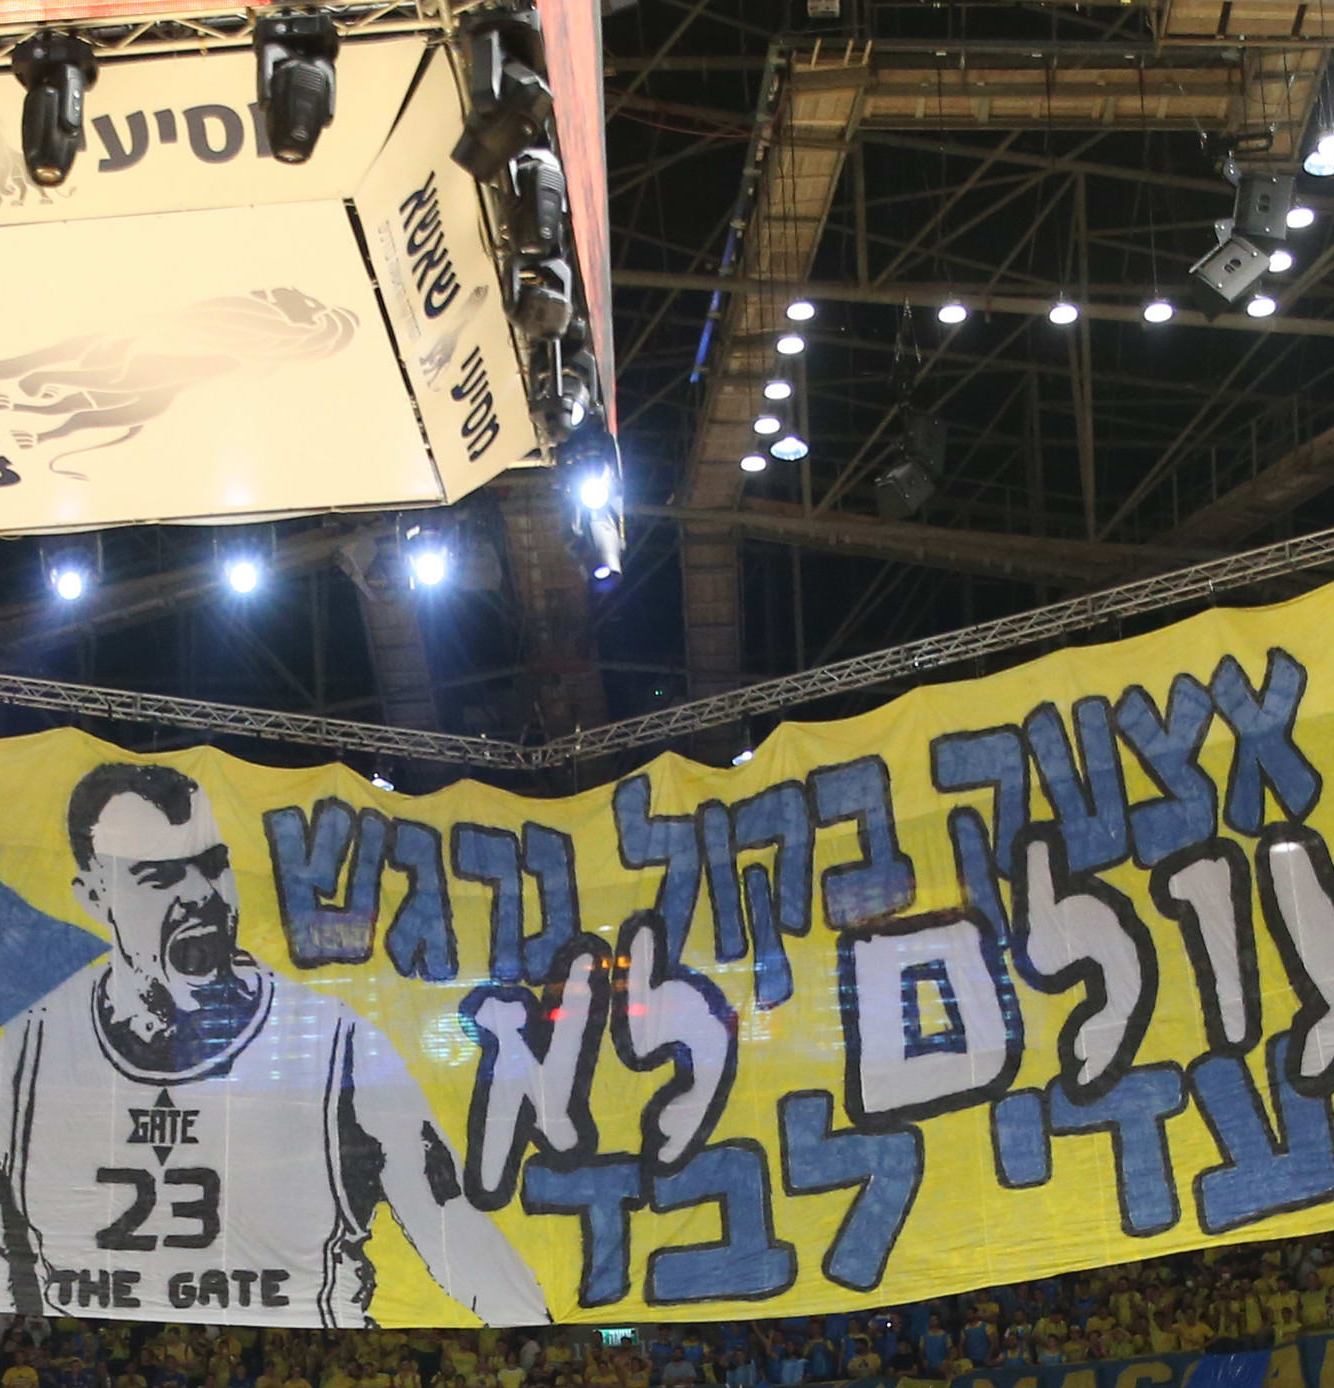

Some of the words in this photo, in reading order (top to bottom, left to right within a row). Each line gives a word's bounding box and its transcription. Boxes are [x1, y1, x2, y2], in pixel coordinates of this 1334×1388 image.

[79, 102, 272, 172] סיע
[399, 170, 461, 320] שאשא
[929, 646, 1323, 940] אצעק
[265, 795, 589, 985] נרגש
[613, 755, 916, 1010] בקול
[126, 1108, 201, 1144] GATE
[467, 909, 740, 1207] לא
[95, 1167, 221, 1251] 23
[520, 1089, 924, 1312] לבד
[52, 1269, 141, 1308] THE
[168, 1269, 291, 1308] GATE
